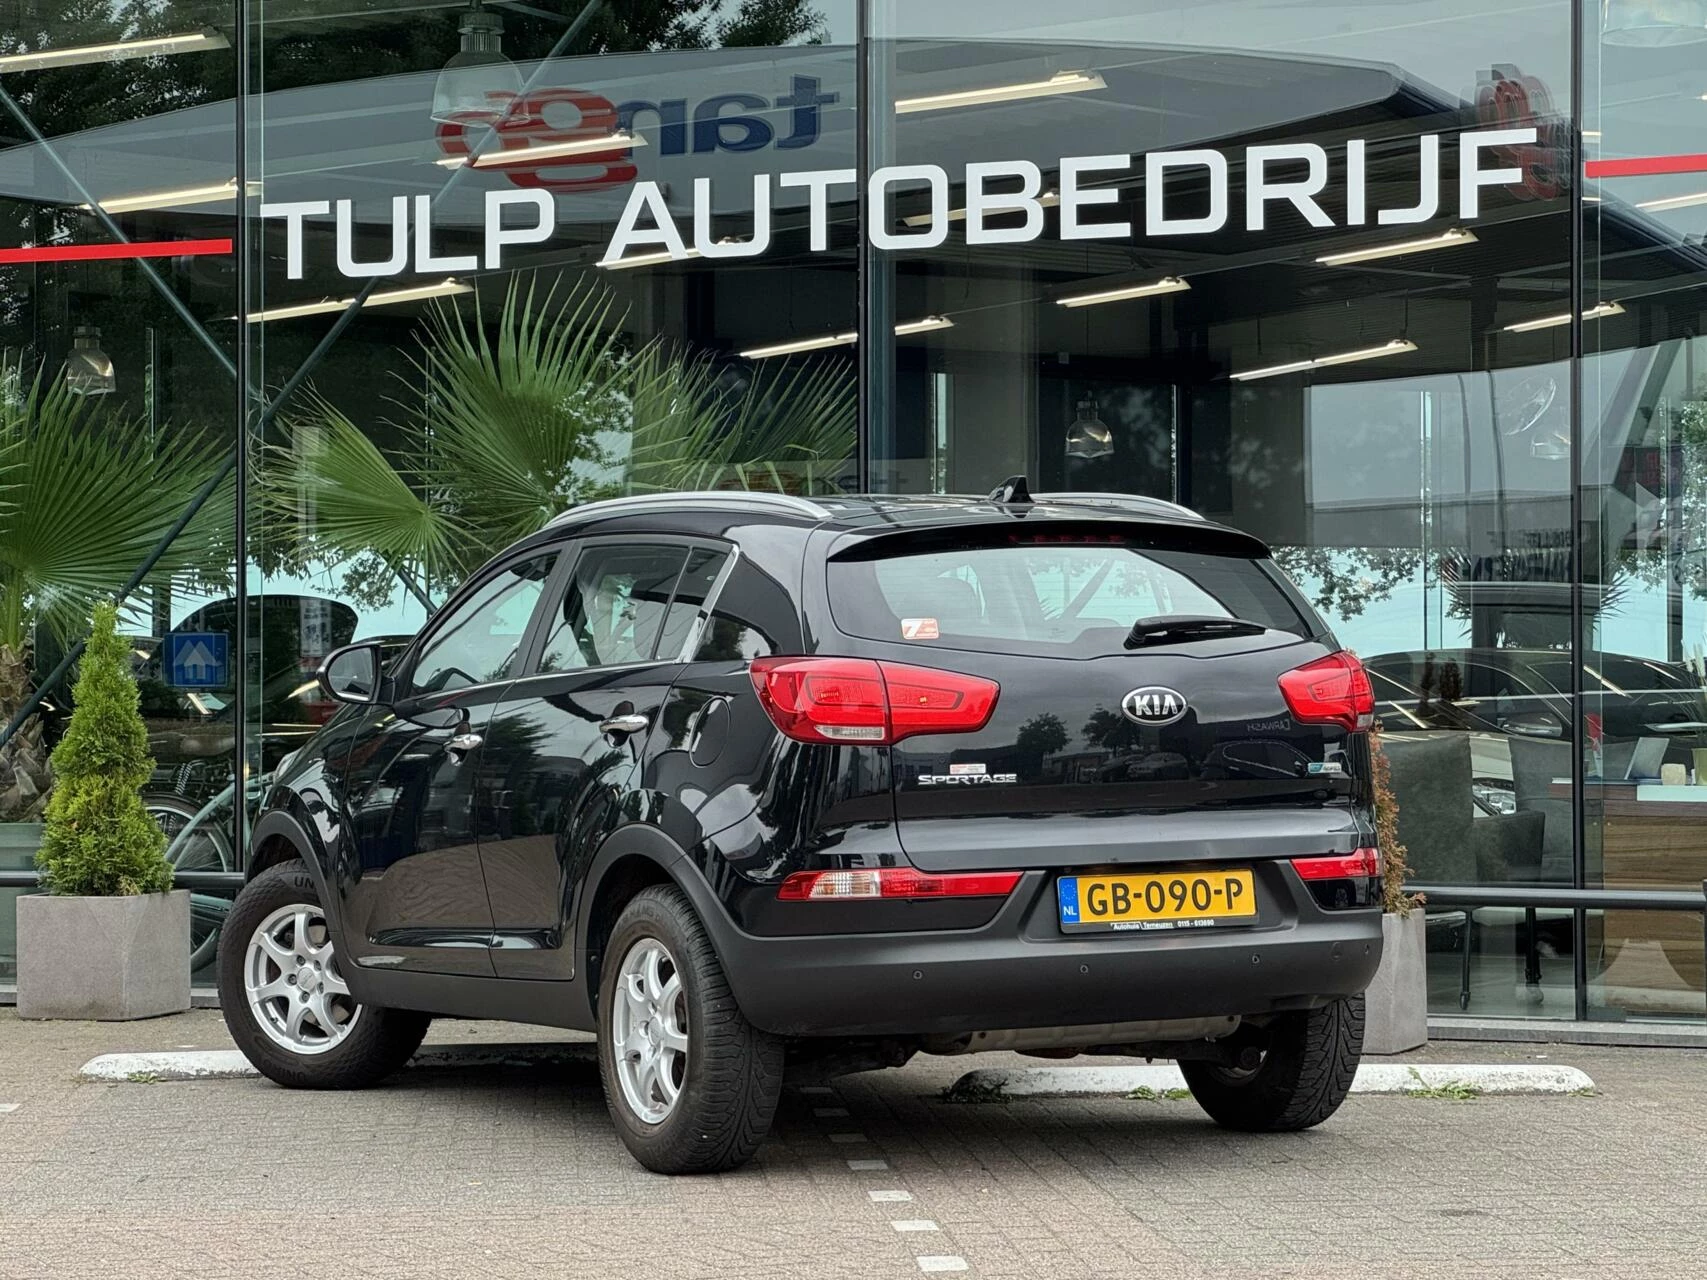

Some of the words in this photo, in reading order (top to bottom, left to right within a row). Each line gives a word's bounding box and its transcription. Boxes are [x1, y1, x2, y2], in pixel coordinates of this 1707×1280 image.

[260, 188, 556, 280] TULP
[601, 127, 1537, 266] AUTOBEDRIJF
[1133, 694, 1178, 716] KIA
[918, 773, 1017, 785] SPORTAGE
[1086, 878, 1243, 916] GB-090-P
[1063, 906, 1077, 916] NL
